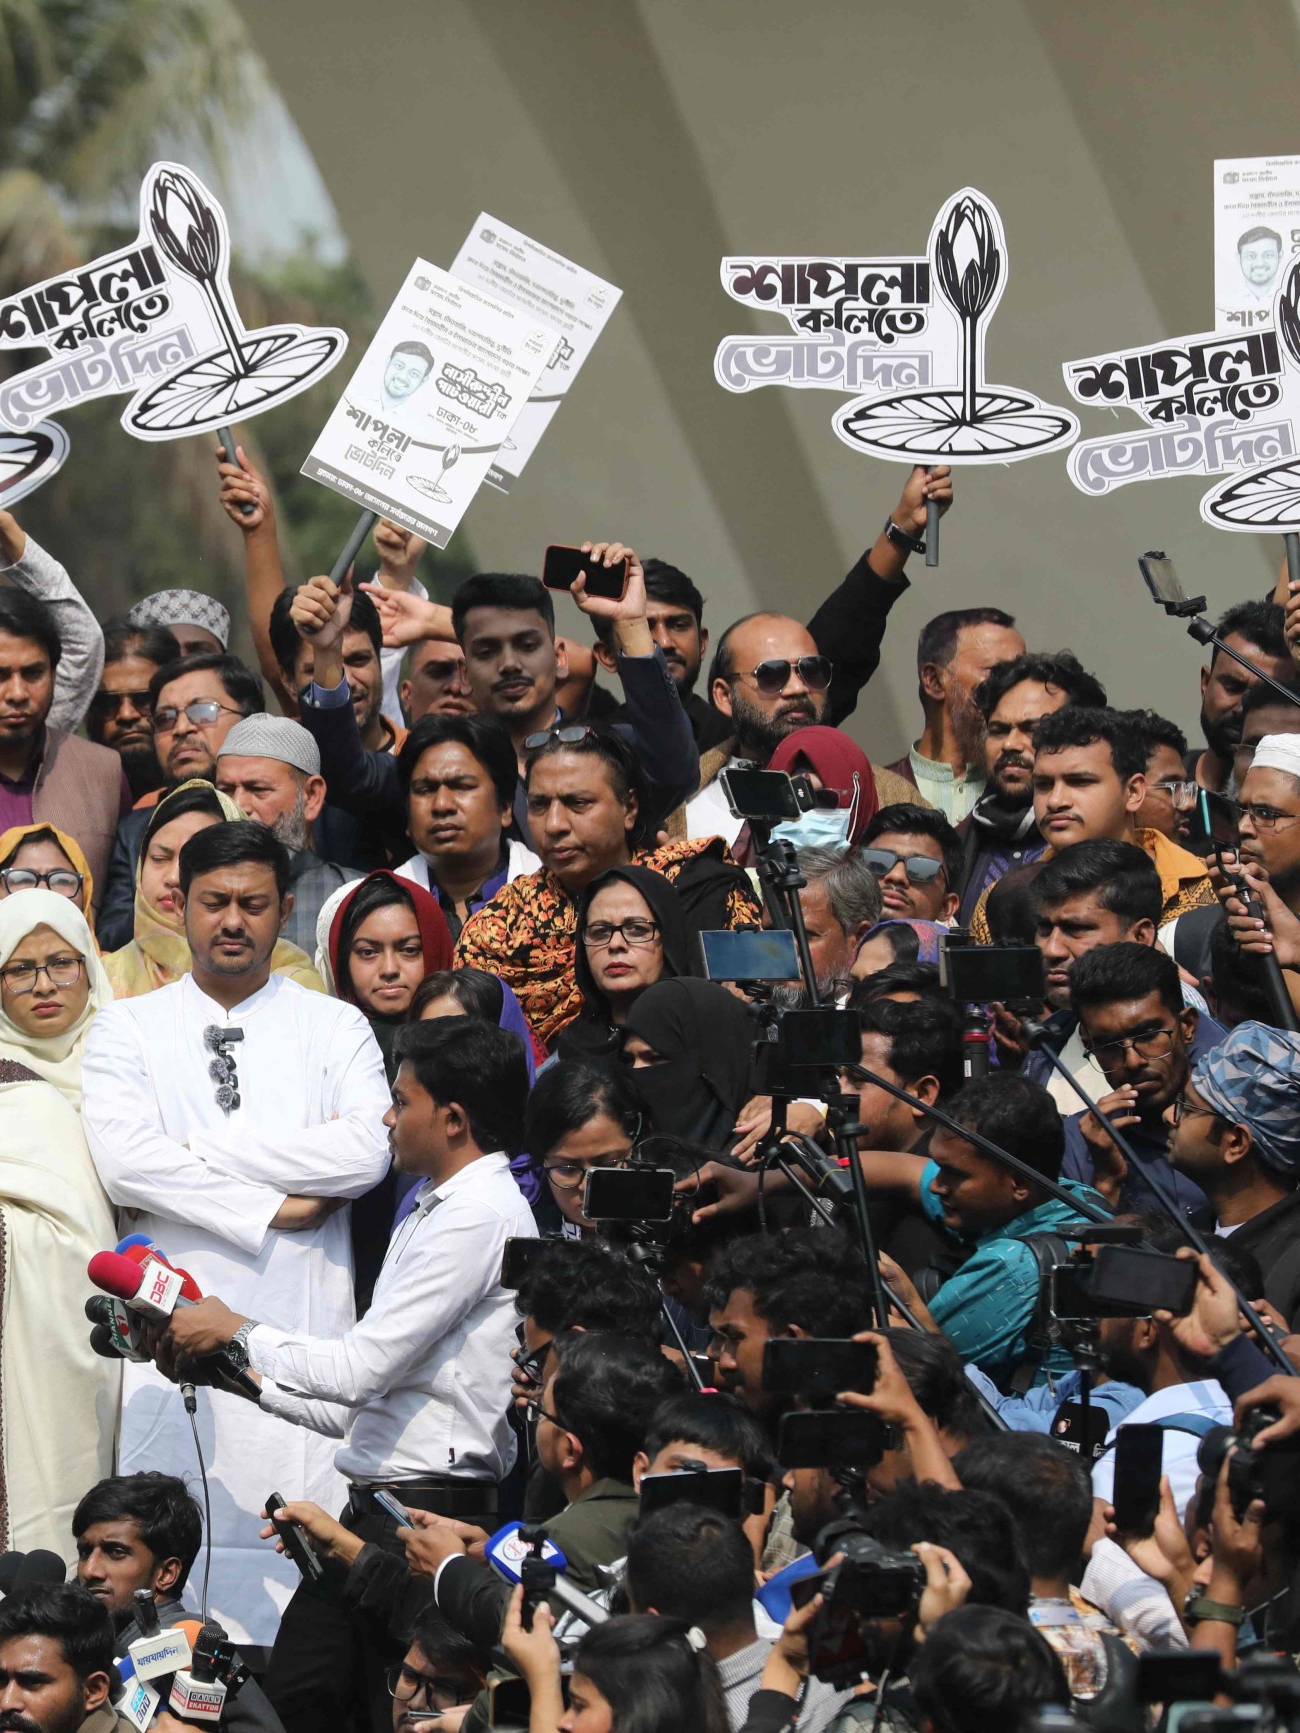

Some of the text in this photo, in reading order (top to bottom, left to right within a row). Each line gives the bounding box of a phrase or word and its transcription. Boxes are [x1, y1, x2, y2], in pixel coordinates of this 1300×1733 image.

[729, 262, 930, 306] শাপলা
[48, 287, 170, 350] কলিতে
[794, 296, 925, 343] কলিতে
[1072, 331, 1282, 400] শাপলা
[1144, 377, 1280, 423] কলিতে
[341, 404, 413, 453] শাপলা
[364, 433, 406, 465] কলিতে
[414, 520, 437, 536] জনগণ
[150, 1271, 169, 1304] DBC
[137, 1647, 178, 1666] যায়যায়দিন
[189, 1703, 220, 1713] EKATTOR
[190, 1692, 222, 1704] DAILY
